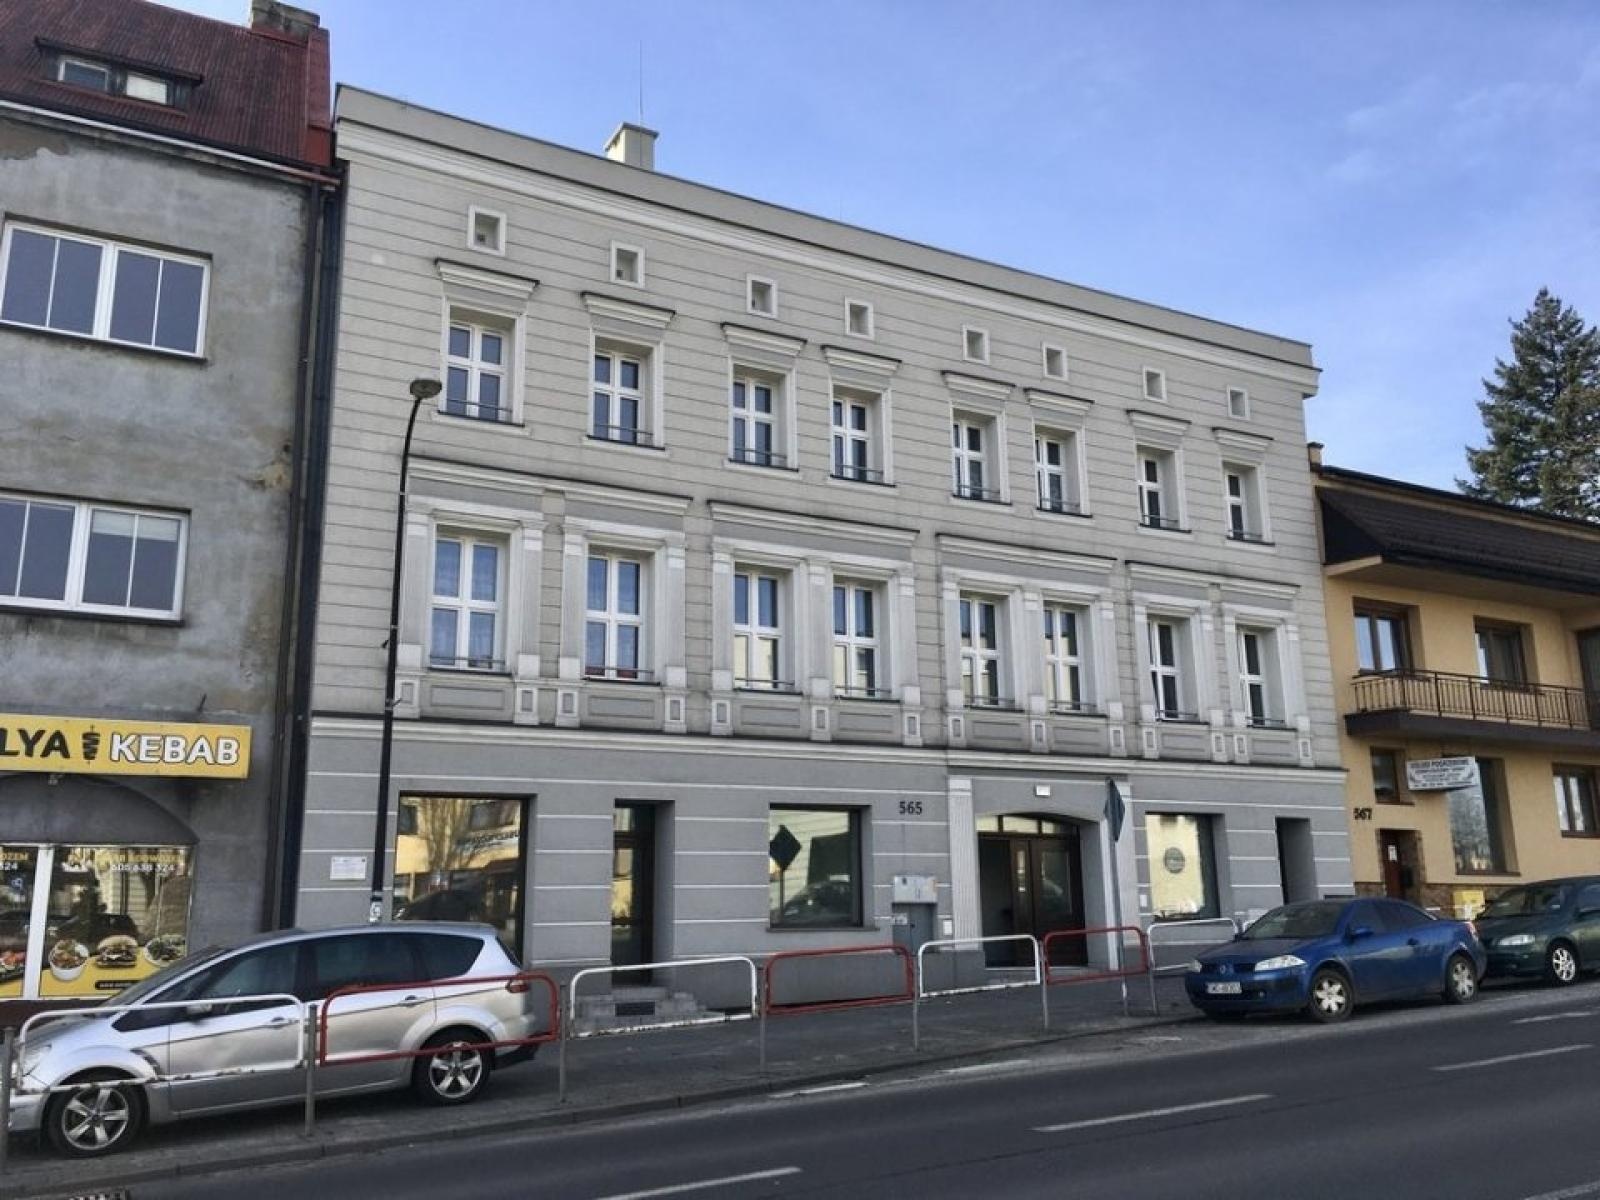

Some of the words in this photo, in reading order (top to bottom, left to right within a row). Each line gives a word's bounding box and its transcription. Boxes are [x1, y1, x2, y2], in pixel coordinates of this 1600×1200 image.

[0, 727, 70, 759] LYA
[110, 732, 241, 765] KEBAB
[899, 801, 922, 815] 565
